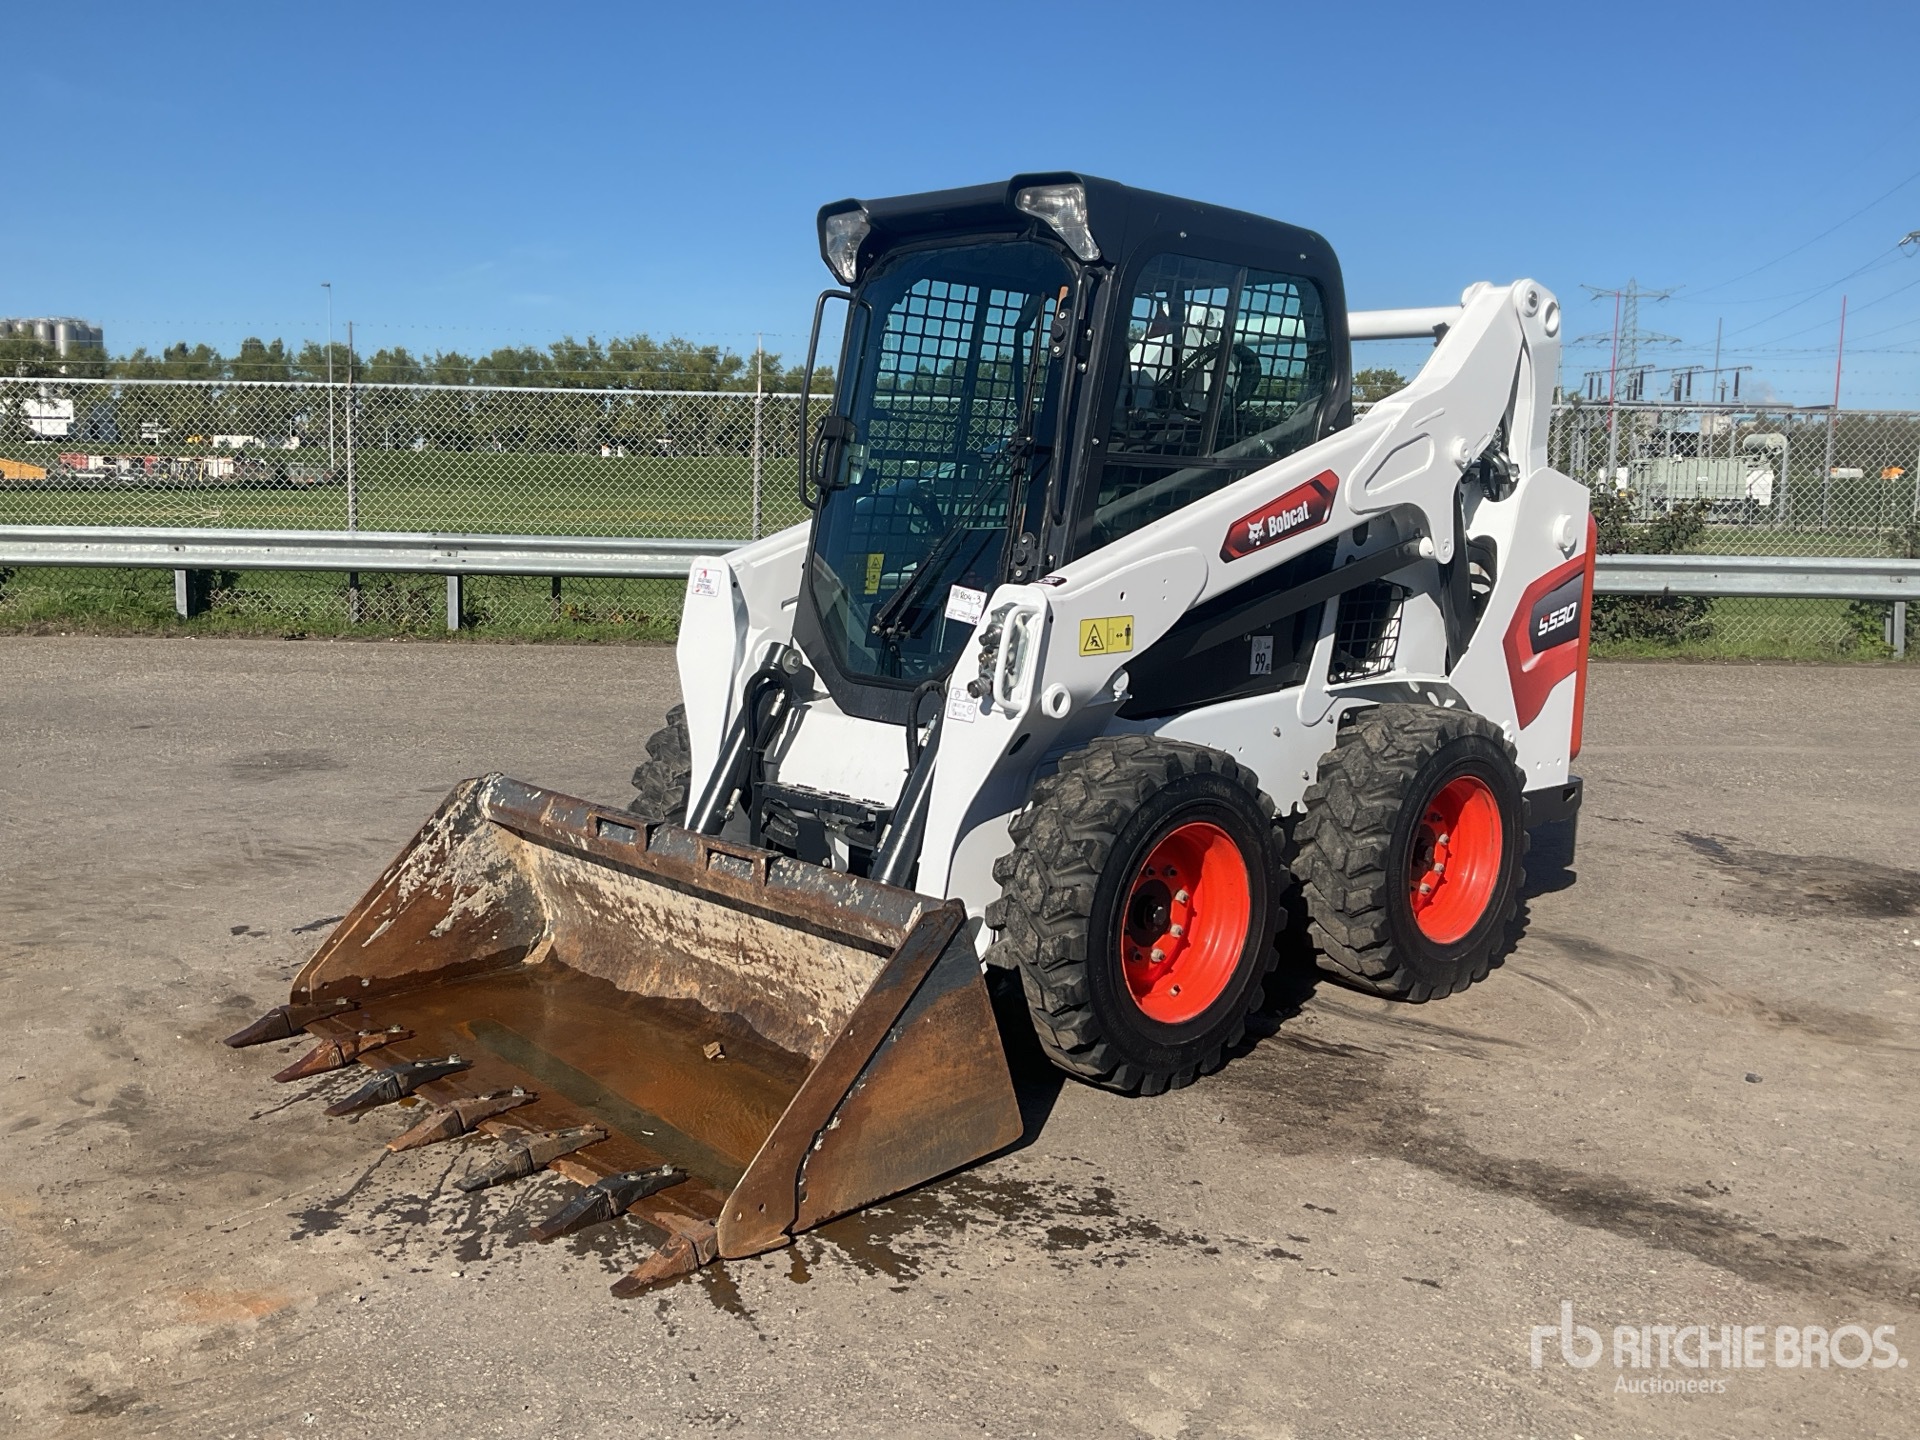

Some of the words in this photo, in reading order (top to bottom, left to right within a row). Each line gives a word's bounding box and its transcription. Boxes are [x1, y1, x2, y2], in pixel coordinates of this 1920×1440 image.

[1268, 500, 1309, 537] Bobcat
[1538, 601, 1577, 636] S530
[1255, 652, 1266, 672] 99
